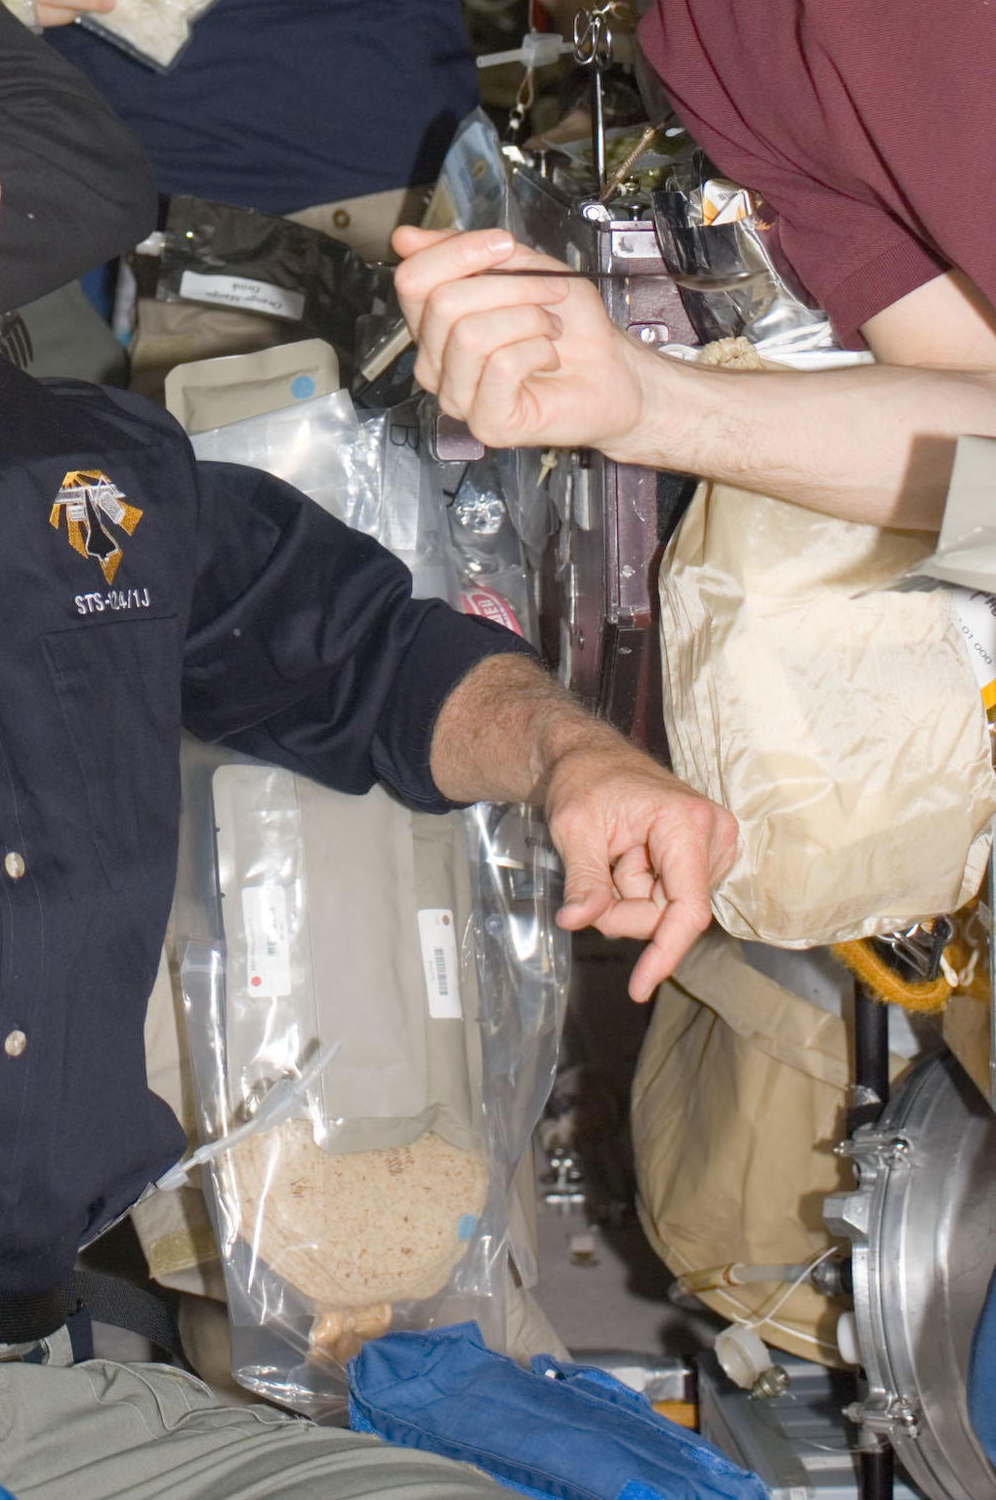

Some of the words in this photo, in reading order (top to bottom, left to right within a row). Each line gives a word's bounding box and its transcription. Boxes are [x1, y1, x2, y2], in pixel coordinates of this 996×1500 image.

[232, 282, 261, 294] Drink
[205, 290, 283, 310] Orange-Mango
[74, 588, 151, 615] STS-124/1J
